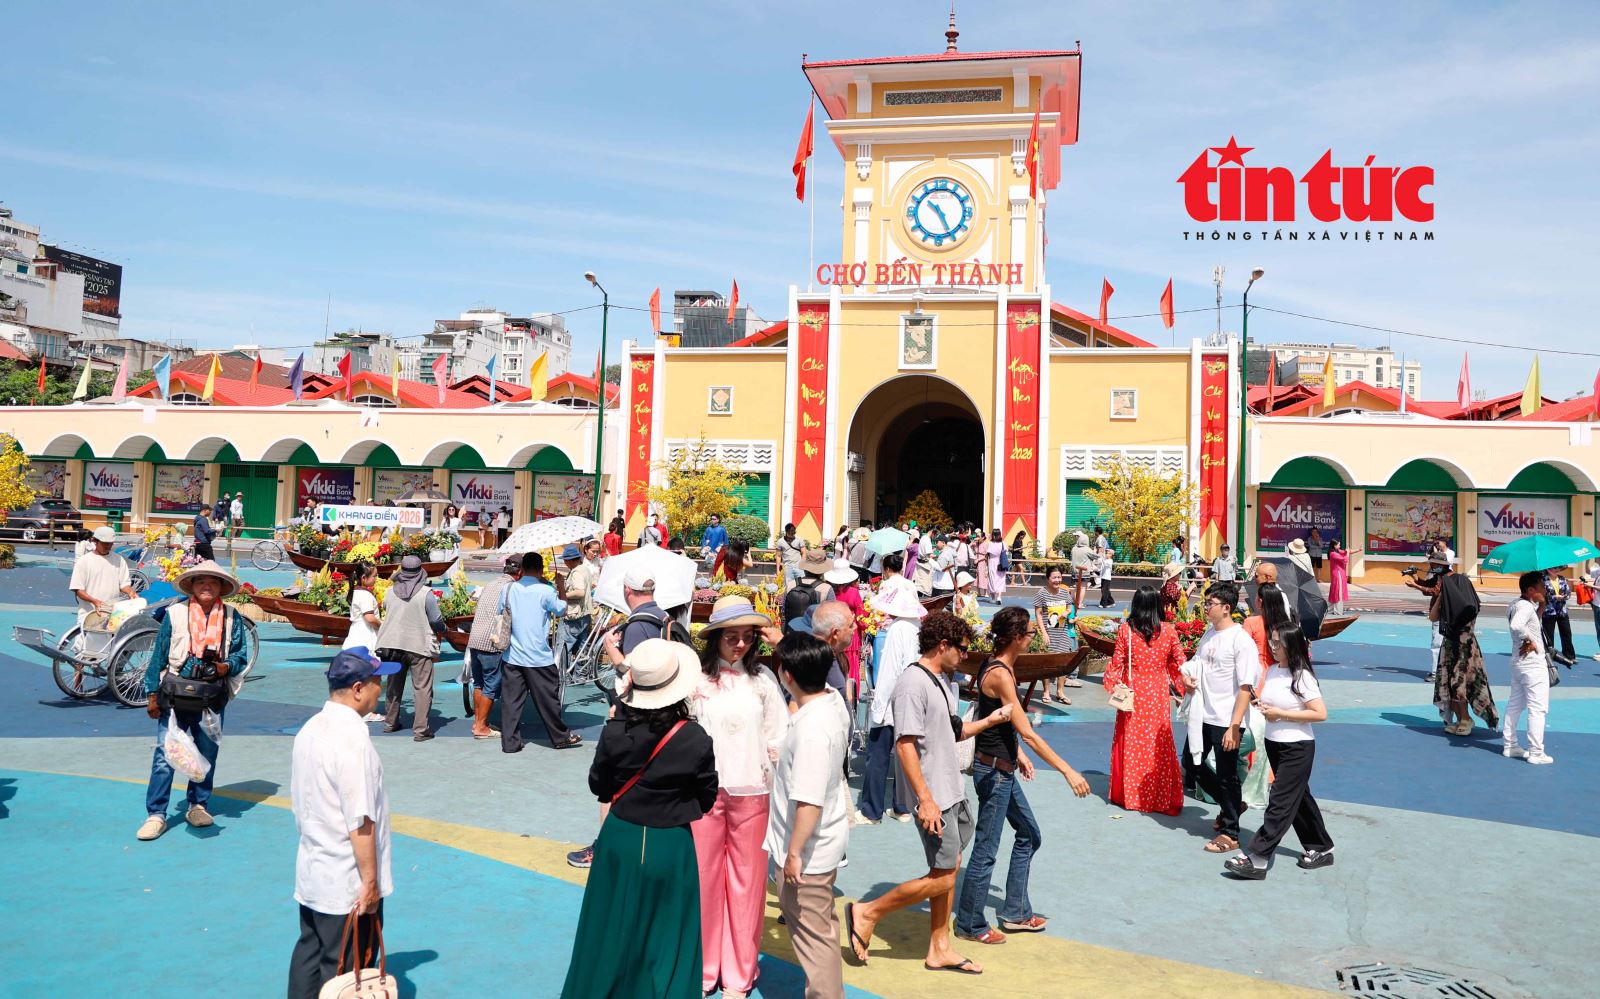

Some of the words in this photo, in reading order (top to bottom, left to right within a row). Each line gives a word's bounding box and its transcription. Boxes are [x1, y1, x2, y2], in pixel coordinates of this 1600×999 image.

[816, 261, 867, 288] CHỢ
[874, 256, 923, 285] BẾN
[931, 258, 1023, 285] THÀNH
[88, 282, 108, 295] 2025
[1008, 356, 1038, 385] Happy
[1010, 447, 1033, 460] 2026
[90, 467, 119, 487] Vikki
[302, 472, 336, 495] Vikki
[456, 477, 492, 500] Vikki
[338, 511, 372, 520] KHANG
[400, 510, 420, 524] 2026
[1264, 496, 1312, 522] Vikki
[1484, 502, 1535, 529] Vikki
